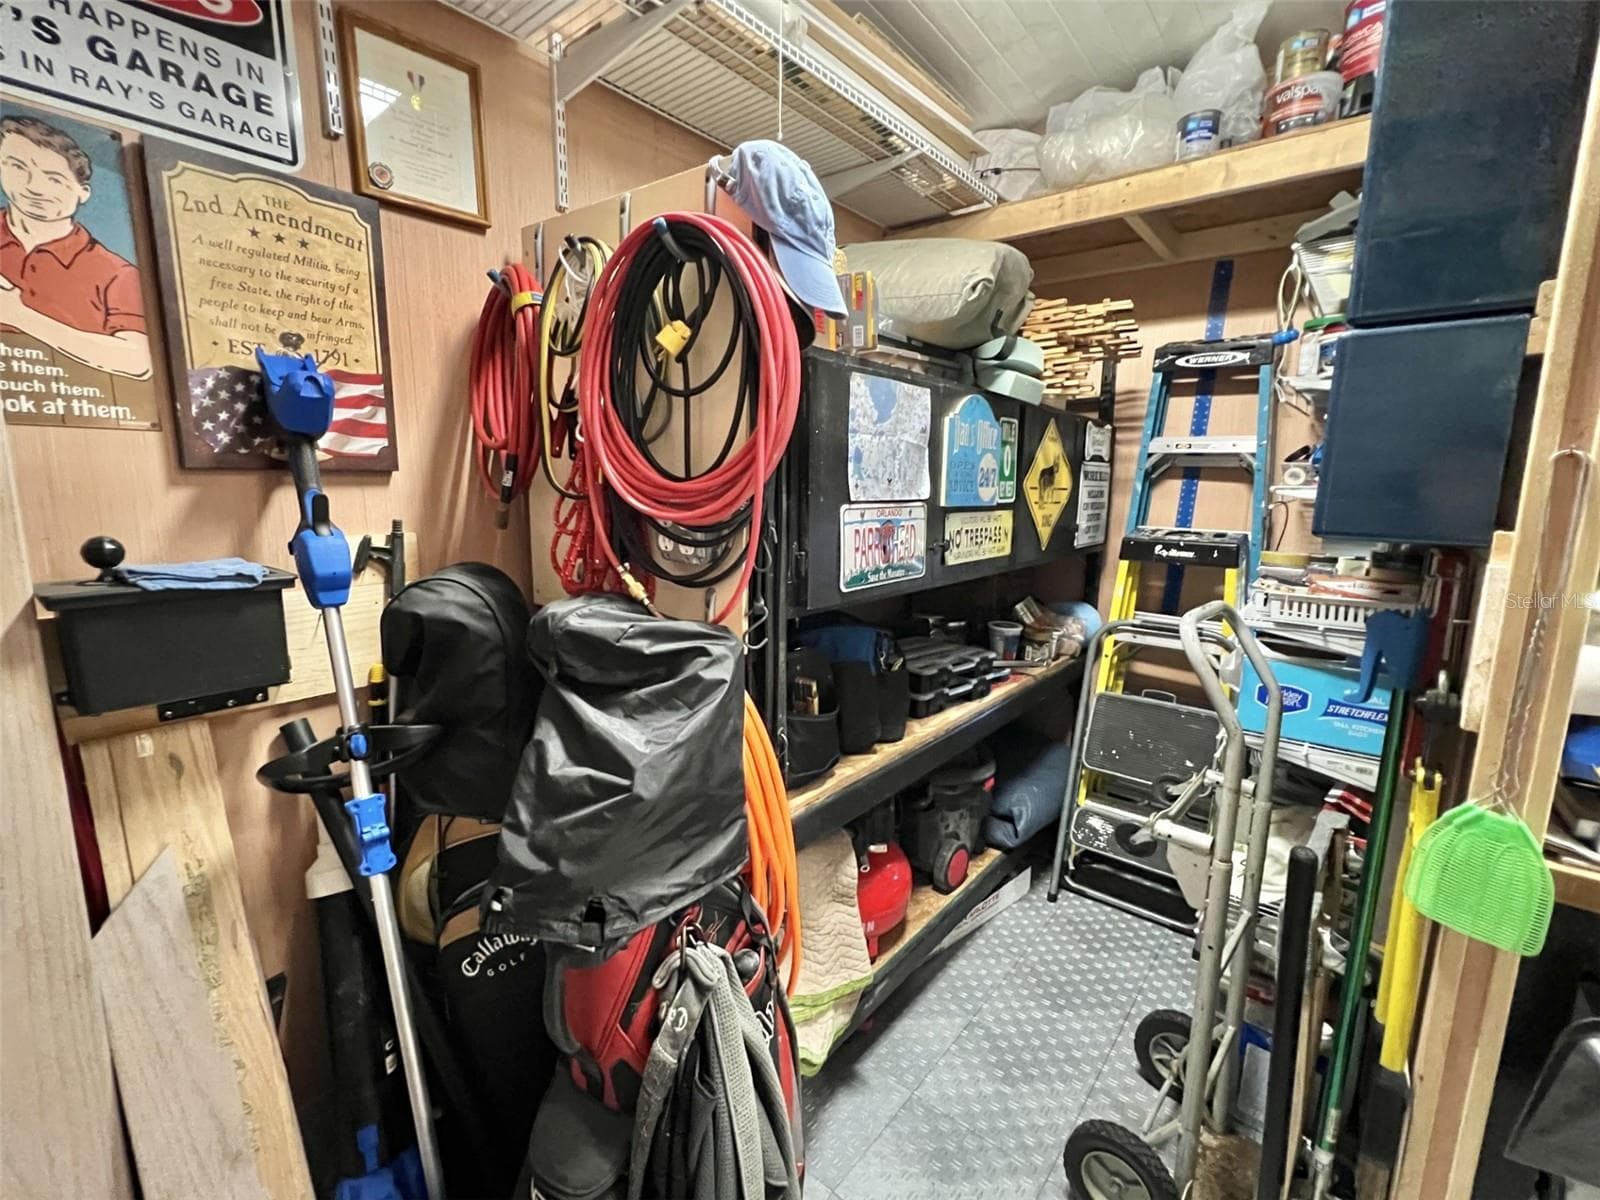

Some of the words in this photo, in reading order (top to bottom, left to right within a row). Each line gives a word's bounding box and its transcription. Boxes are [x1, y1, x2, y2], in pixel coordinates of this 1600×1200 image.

[49, 0, 222, 68] HAPPENS
[235, 57, 264, 85] IN
[9, 6, 61, 45] 'S
[86, 34, 275, 117] GARAGE
[20, 50, 54, 77] IN
[69, 65, 166, 110] RAY'S
[177, 101, 290, 149] GARAGE
[262, 194, 292, 211] THE
[176, 190, 224, 215] 2nd
[233, 197, 365, 252] Amendment
[192, 233, 204, 246] A
[209, 239, 233, 251] well
[236, 246, 290, 263] regulated
[335, 263, 361, 280] being
[199, 257, 256, 278] necessary
[260, 269, 272, 279] to
[276, 270, 292, 283] the
[295, 275, 336, 294] security
[339, 282, 352, 296] of
[353, 287, 360, 295] a
[209, 276, 233, 291] free
[276, 288, 293, 302] the
[295, 293, 321, 310] right
[323, 298, 337, 310] of
[339, 300, 355, 312] the
[199, 297, 239, 311] people
[243, 302, 257, 313] to
[259, 304, 285, 321] keep
[287, 309, 307, 321] and
[310, 313, 333, 325] bear
[209, 317, 237, 330] shall
[241, 322, 260, 334] not
[264, 324, 277, 335] be
[0, 342, 49, 360] hem.
[1188, 355, 1233, 364] WERNER
[11, 360, 69, 378] them.
[0, 379, 46, 393] ouch
[50, 381, 105, 398] them.
[4, 394, 38, 414] ok
[42, 398, 67, 415] at
[71, 398, 137, 420] them.
[1326, 704, 1389, 722] STRETCHFLEX
